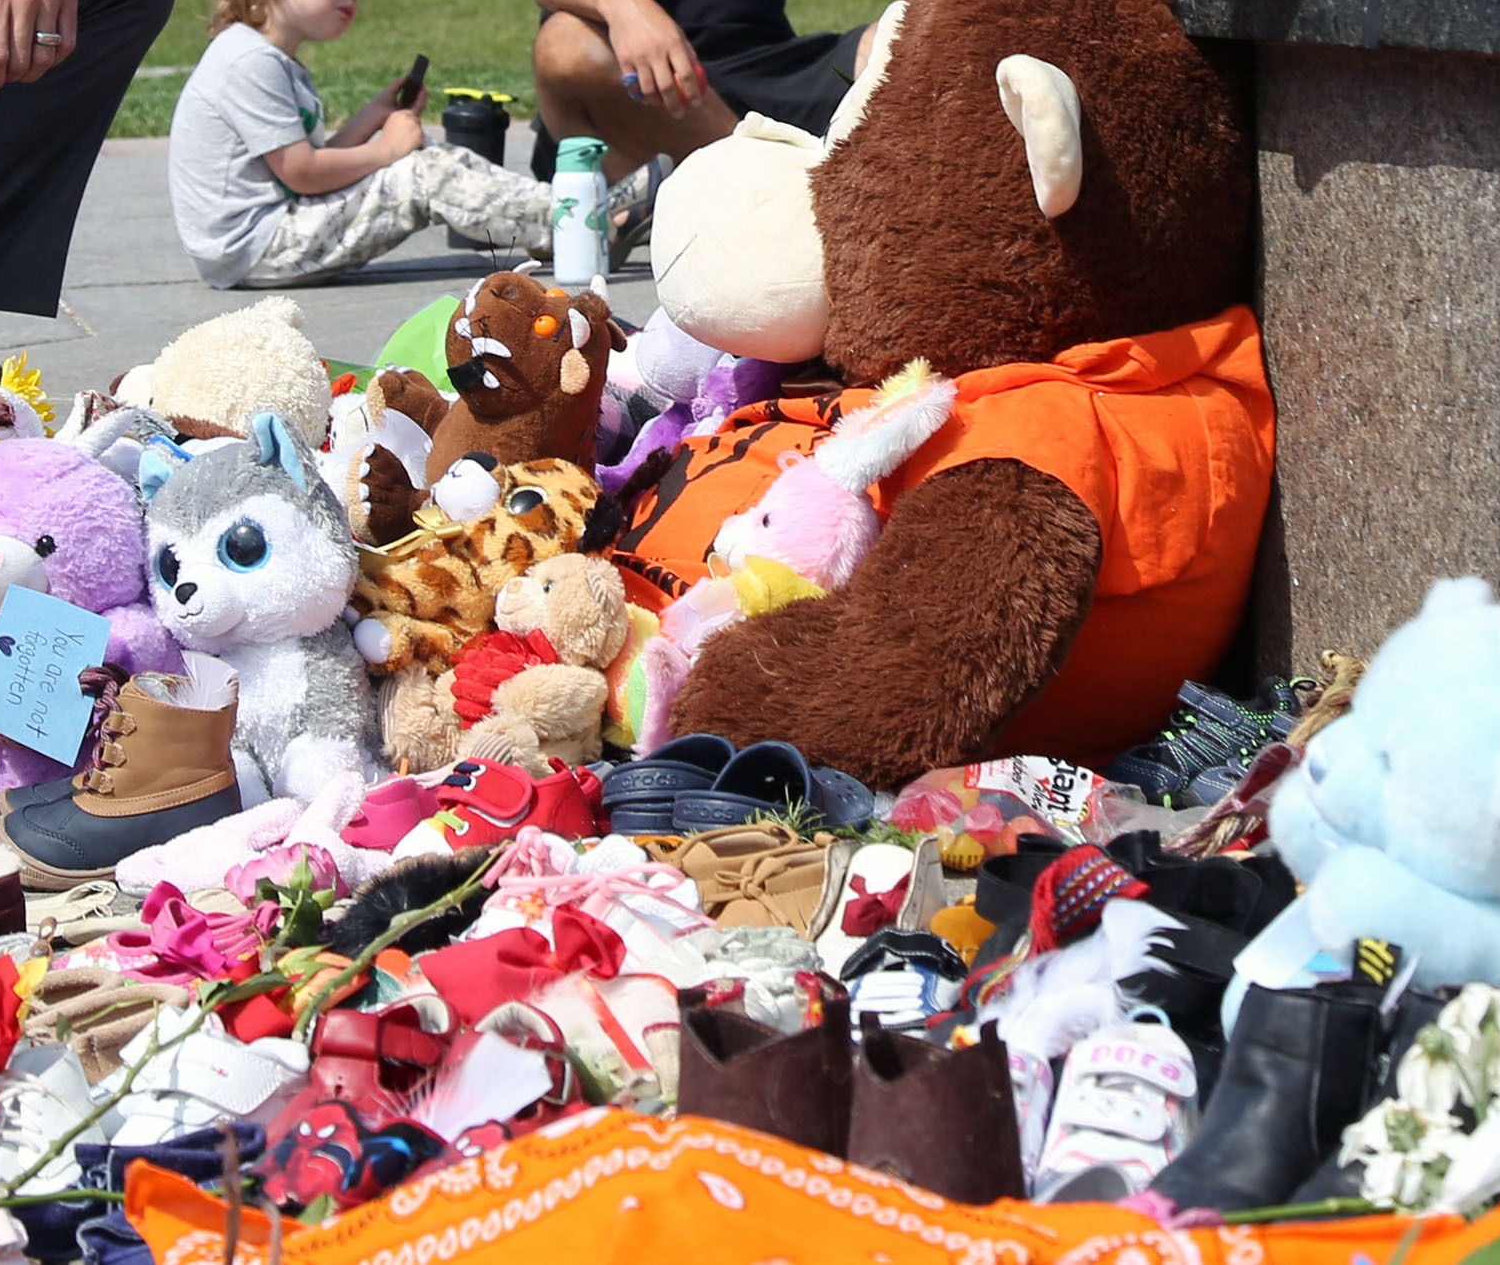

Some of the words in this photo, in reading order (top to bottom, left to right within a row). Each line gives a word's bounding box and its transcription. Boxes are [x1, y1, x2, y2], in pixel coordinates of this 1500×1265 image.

[52, 628, 85, 658] You
[40, 664, 62, 693] are
[26, 699, 49, 738] not
